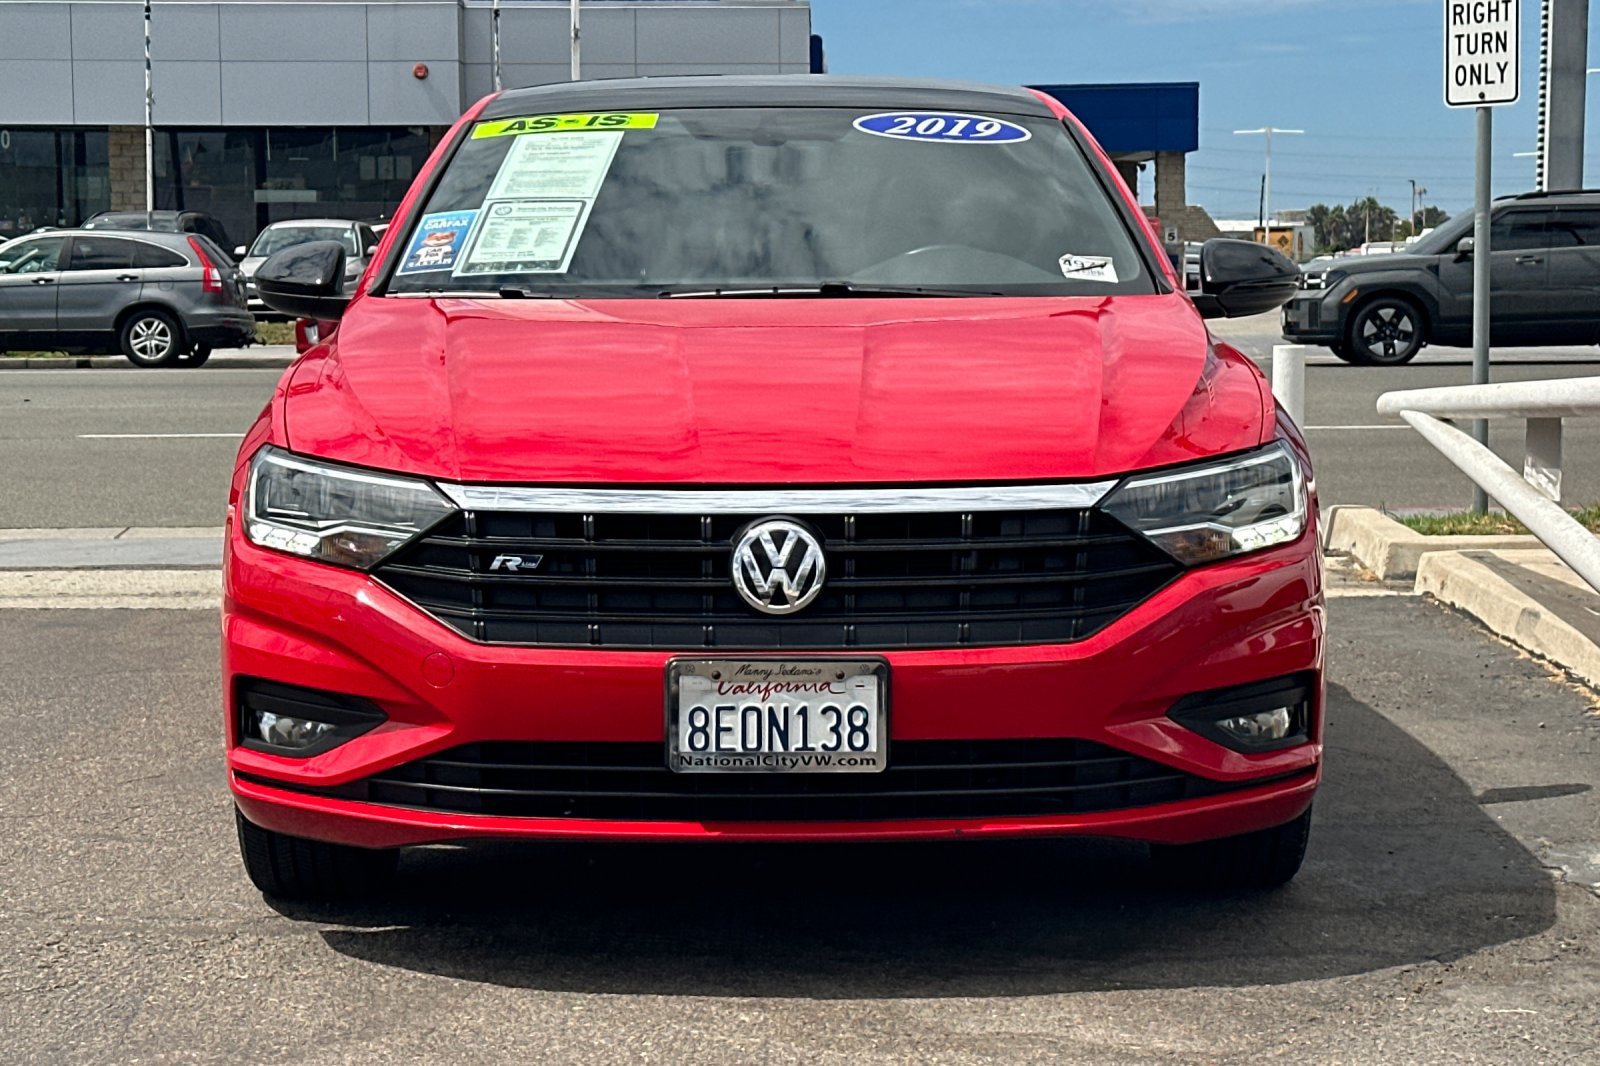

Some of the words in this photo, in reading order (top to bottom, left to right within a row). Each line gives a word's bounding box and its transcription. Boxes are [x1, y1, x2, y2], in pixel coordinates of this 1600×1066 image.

[1453, 0, 1512, 26] RIGHT
[1454, 30, 1507, 56] TURN
[1455, 61, 1509, 86] ONLY
[884, 116, 1002, 137] 2019
[424, 218, 468, 230] CARFAX
[1167, 232, 1175, 242] 5
[735, 664, 774, 680] Manny
[717, 681, 846, 702] California
[680, 754, 877, 767] NationalCityVW.com
